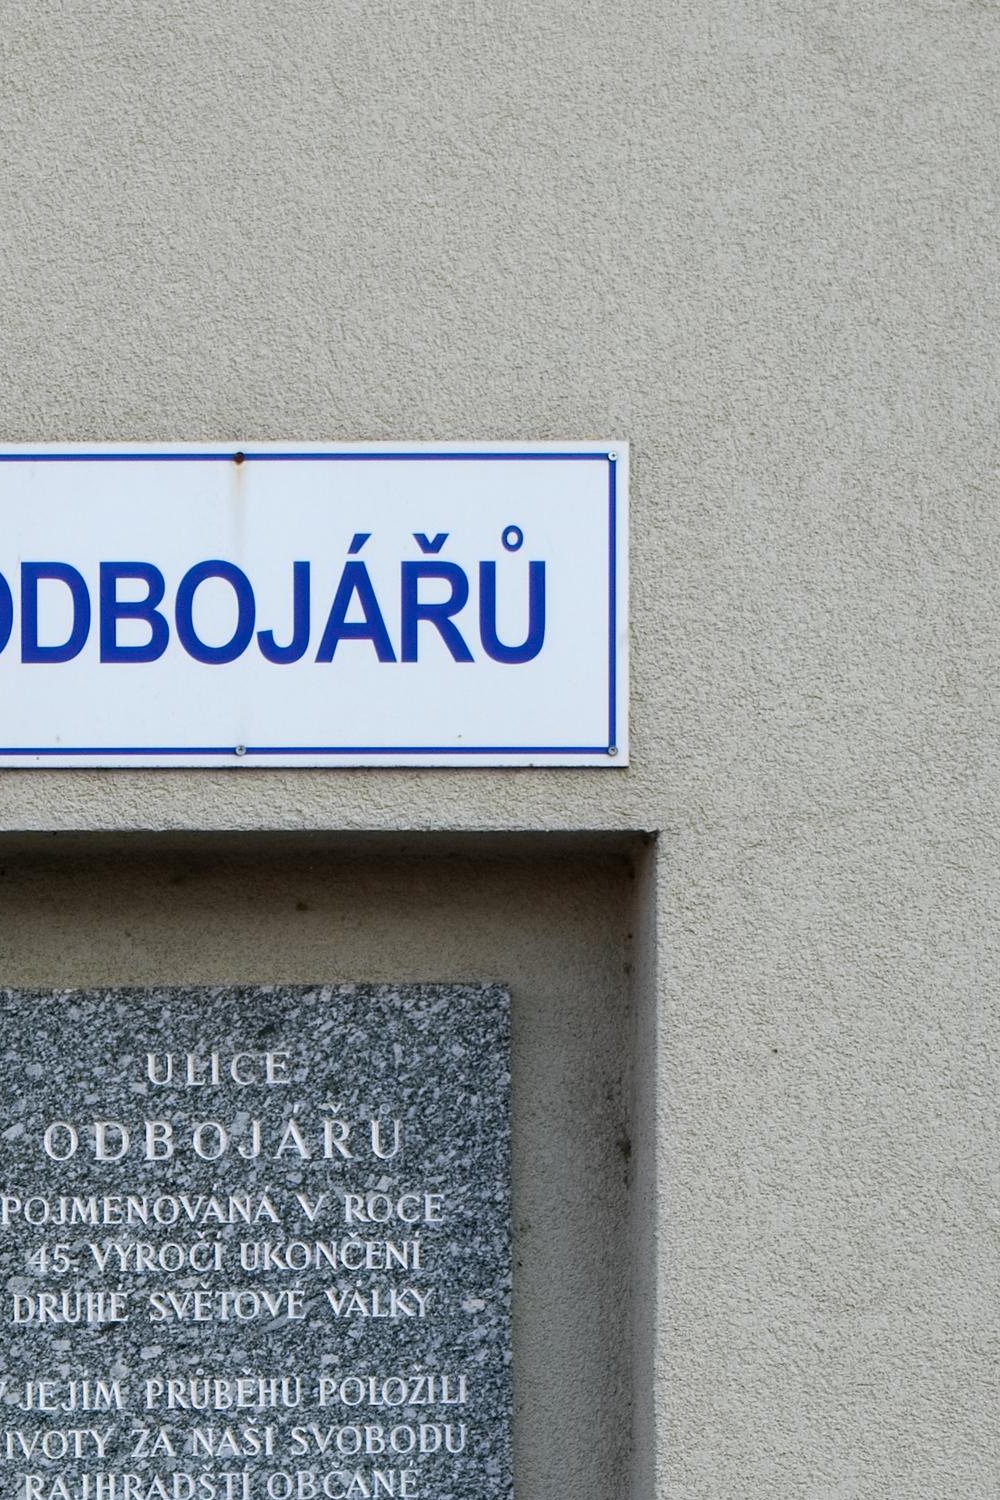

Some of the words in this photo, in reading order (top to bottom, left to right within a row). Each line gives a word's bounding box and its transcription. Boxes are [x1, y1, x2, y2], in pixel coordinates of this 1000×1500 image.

[147, 1051, 293, 1086] ULICE
[44, 1103, 401, 1160] ODBOJÁŘŮ
[296, 1193, 326, 1222] V
[344, 1193, 445, 1223] ROCE
[26, 1243, 79, 1273] 45.
[88, 1231, 224, 1272] VÝROČÍ
[240, 1231, 422, 1271] UKONČENÍ
[13, 1283, 130, 1324] DRUHÉ
[149, 1280, 306, 1322] SVĚTOVÉ
[324, 1279, 435, 1318] VÁLKY
[145, 1367, 301, 1410] PRŮBĚHU
[318, 1365, 467, 1406] POLOŽILI
[130, 1427, 178, 1458] ZA
[191, 1417, 274, 1457] NAŠI
[290, 1423, 467, 1455] SVOBODU
[267, 1460, 420, 1500] OBČANÉ
